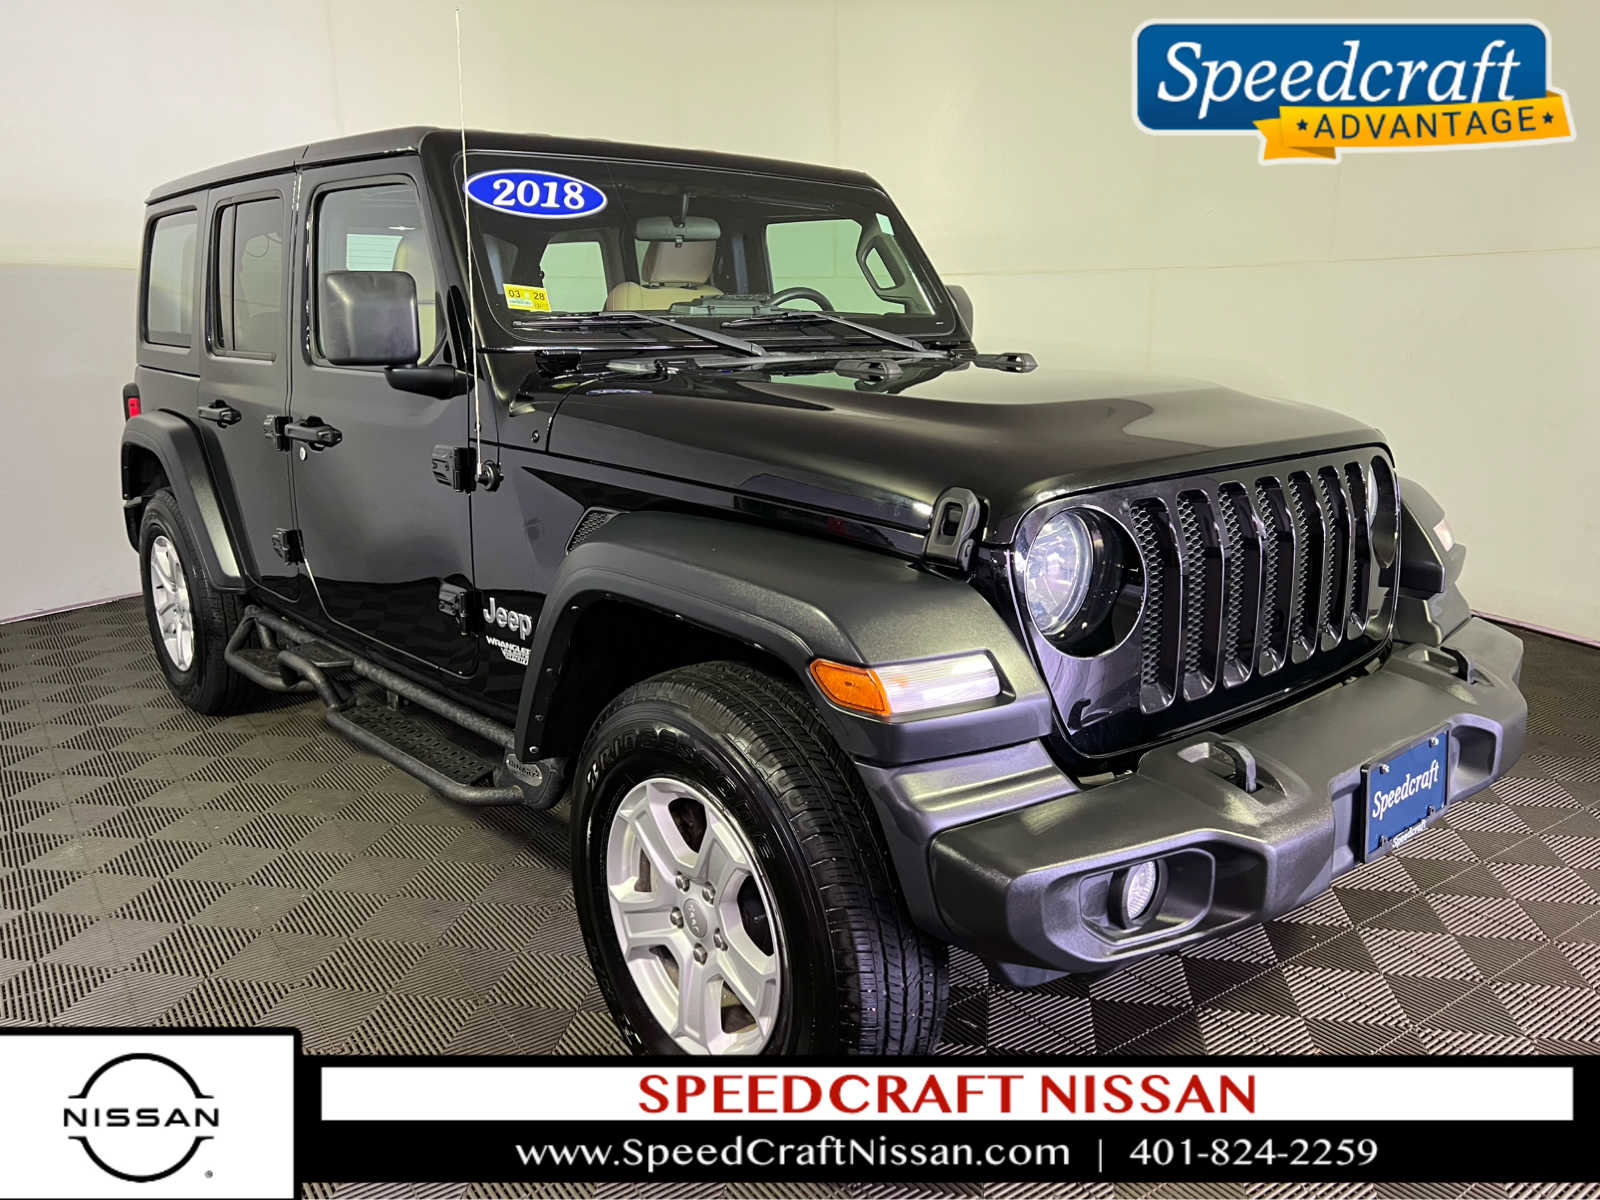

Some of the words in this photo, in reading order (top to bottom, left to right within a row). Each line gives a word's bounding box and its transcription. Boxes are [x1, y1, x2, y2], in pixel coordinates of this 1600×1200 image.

[492, 178, 585, 210] 2018
[482, 596, 532, 641] Jeep
[1372, 759, 1440, 821] Speedcraft
